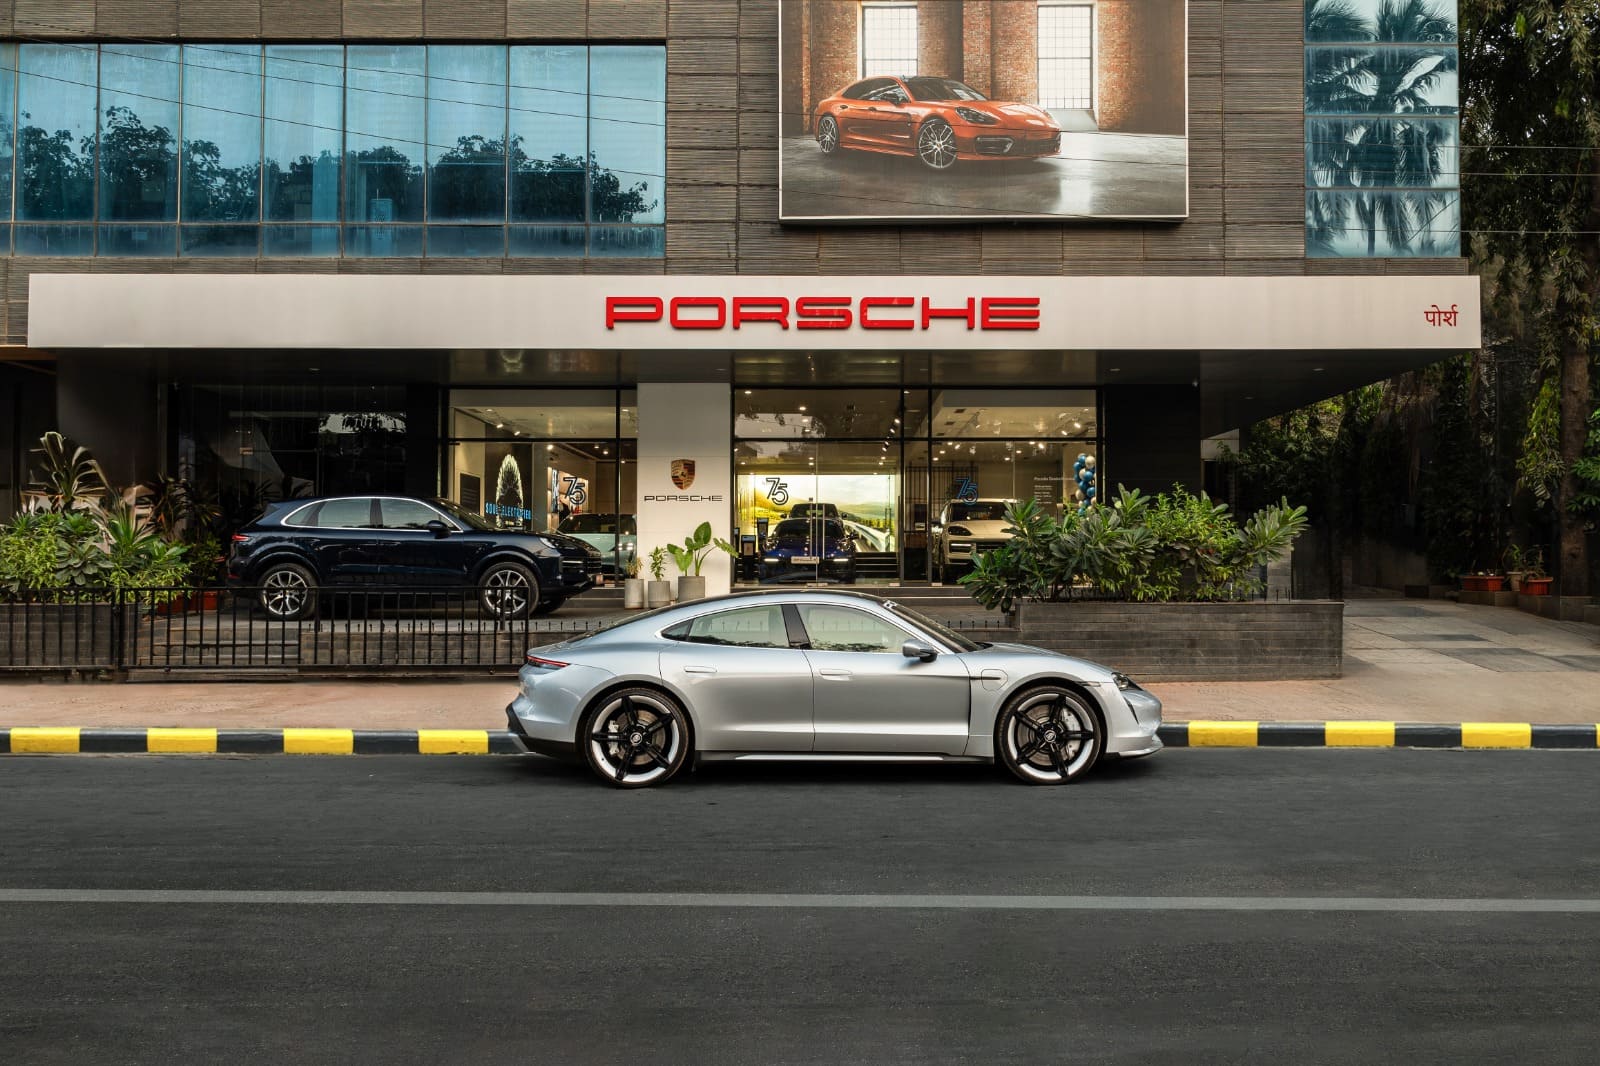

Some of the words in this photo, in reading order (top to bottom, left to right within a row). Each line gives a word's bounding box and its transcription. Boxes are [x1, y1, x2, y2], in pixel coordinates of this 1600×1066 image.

[605, 296, 1041, 331] PORSCHE
[1424, 304, 1459, 327] पोर्श
[563, 476, 586, 505] 75
[765, 477, 789, 506] 75
[955, 477, 978, 506] 75
